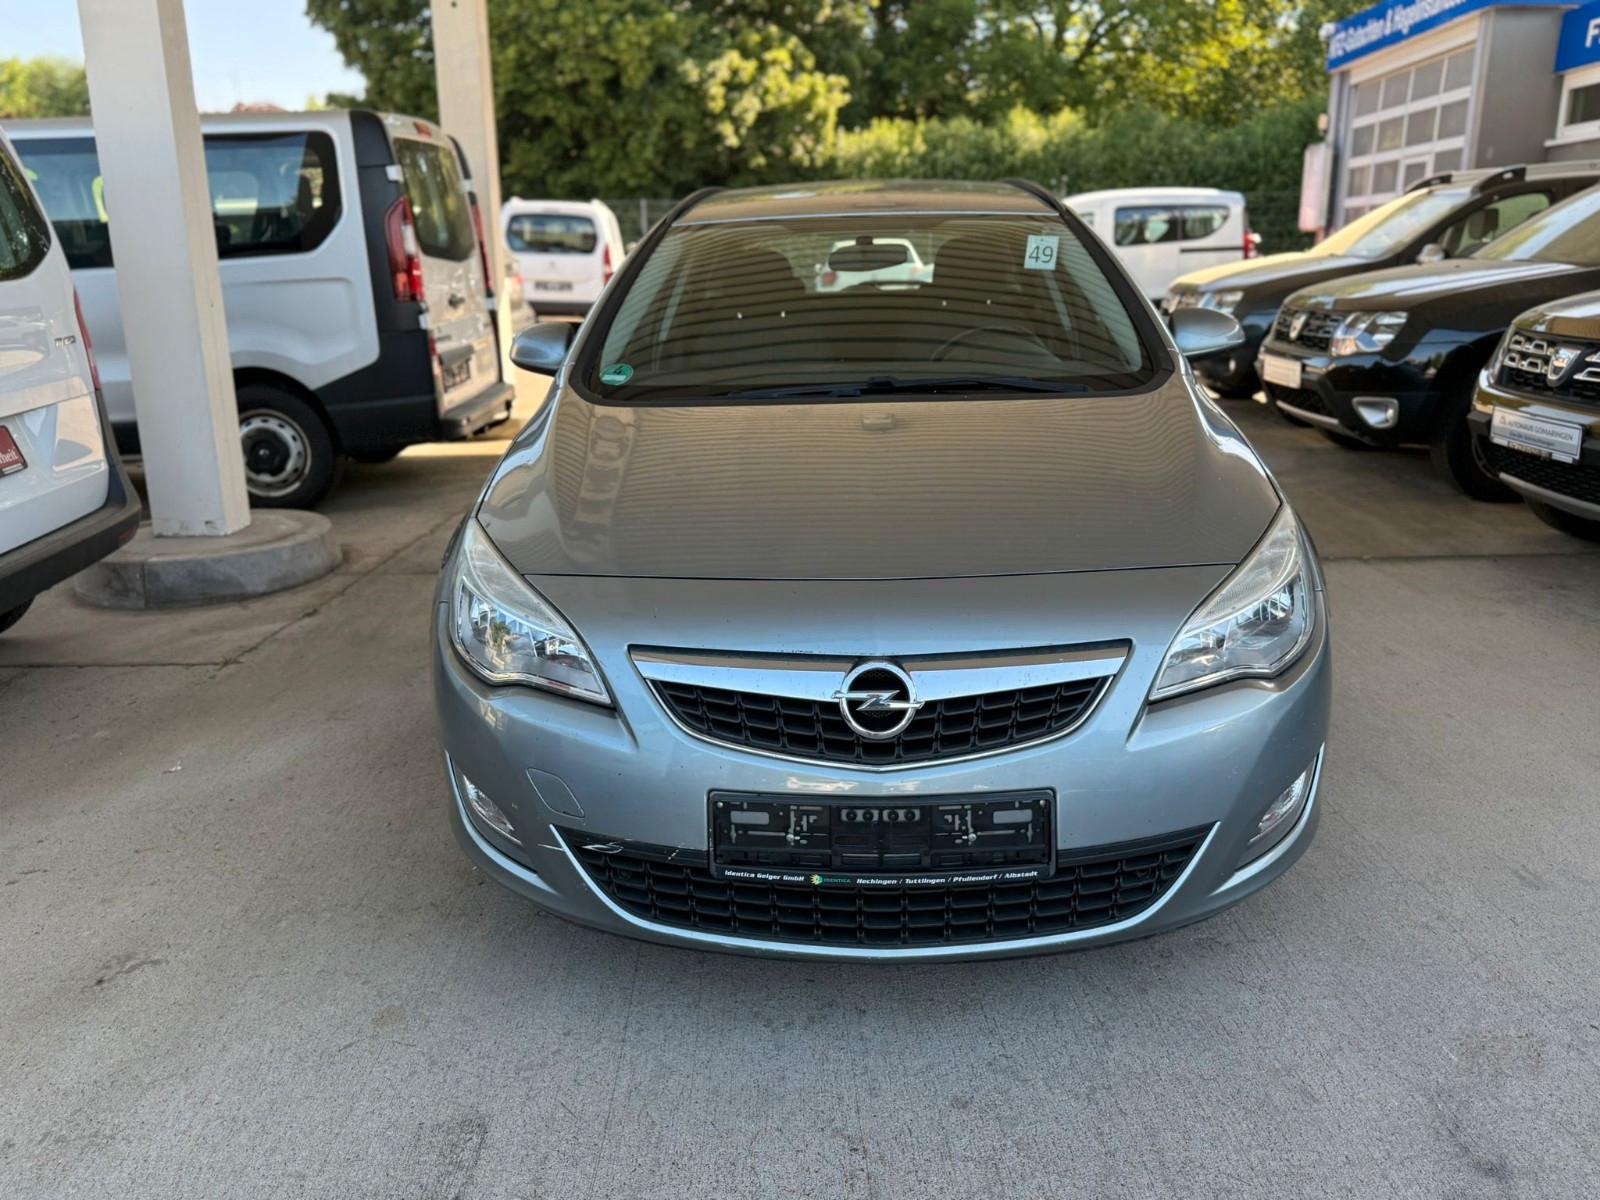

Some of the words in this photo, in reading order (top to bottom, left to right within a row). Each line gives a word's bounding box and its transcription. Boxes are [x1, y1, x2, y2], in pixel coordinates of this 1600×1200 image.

[1028, 245, 1054, 264] 49
[614, 365, 625, 375] 4
[725, 869, 755, 878] Identica
[782, 874, 805, 882] GmbH
